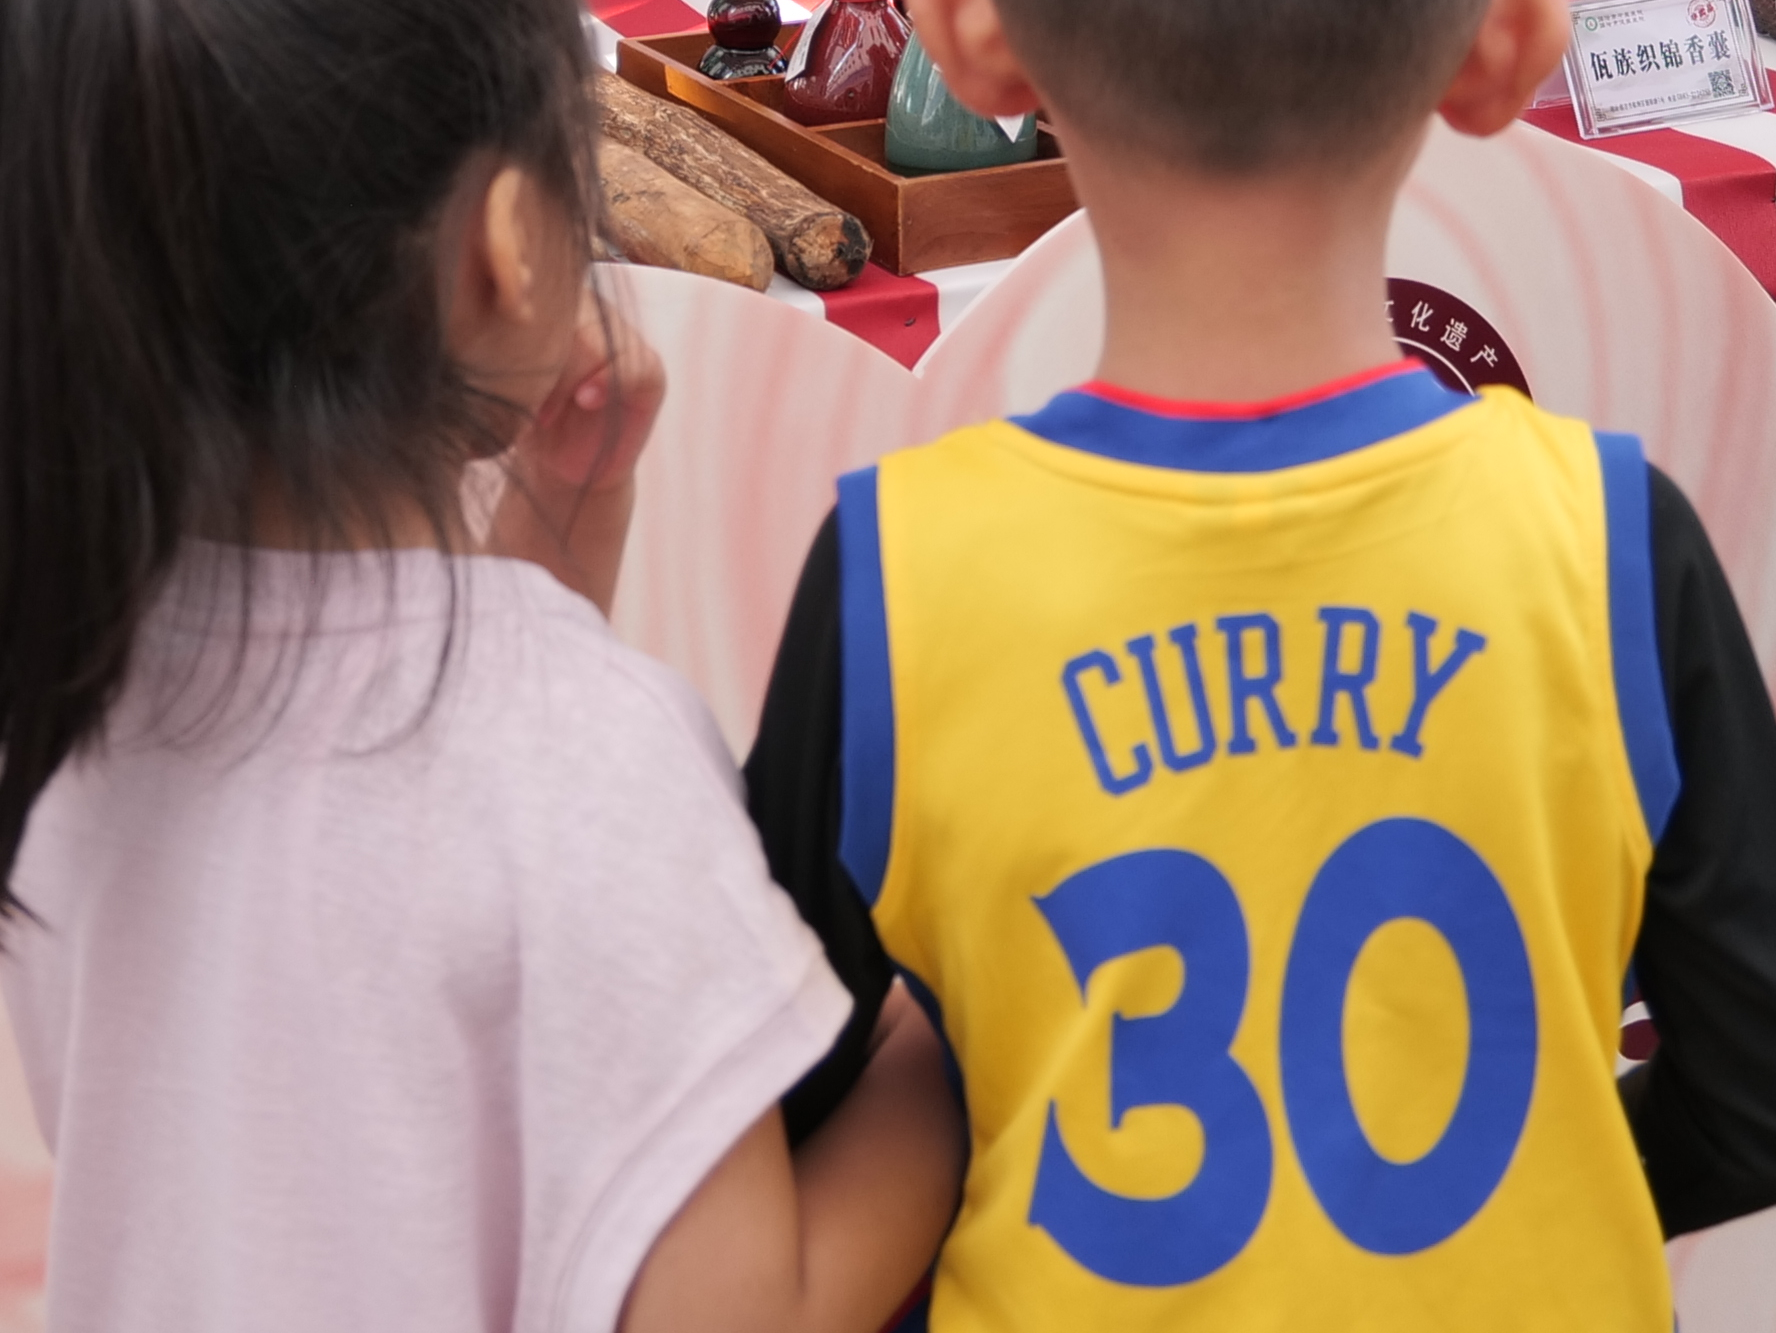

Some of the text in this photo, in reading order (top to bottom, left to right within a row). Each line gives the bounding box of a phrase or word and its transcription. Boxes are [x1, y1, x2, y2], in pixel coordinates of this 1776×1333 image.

[1589, 29, 1731, 82] 佤族织锦香囊
[1060, 605, 1487, 797] CURRY
[1027, 815, 1539, 1289] 30
